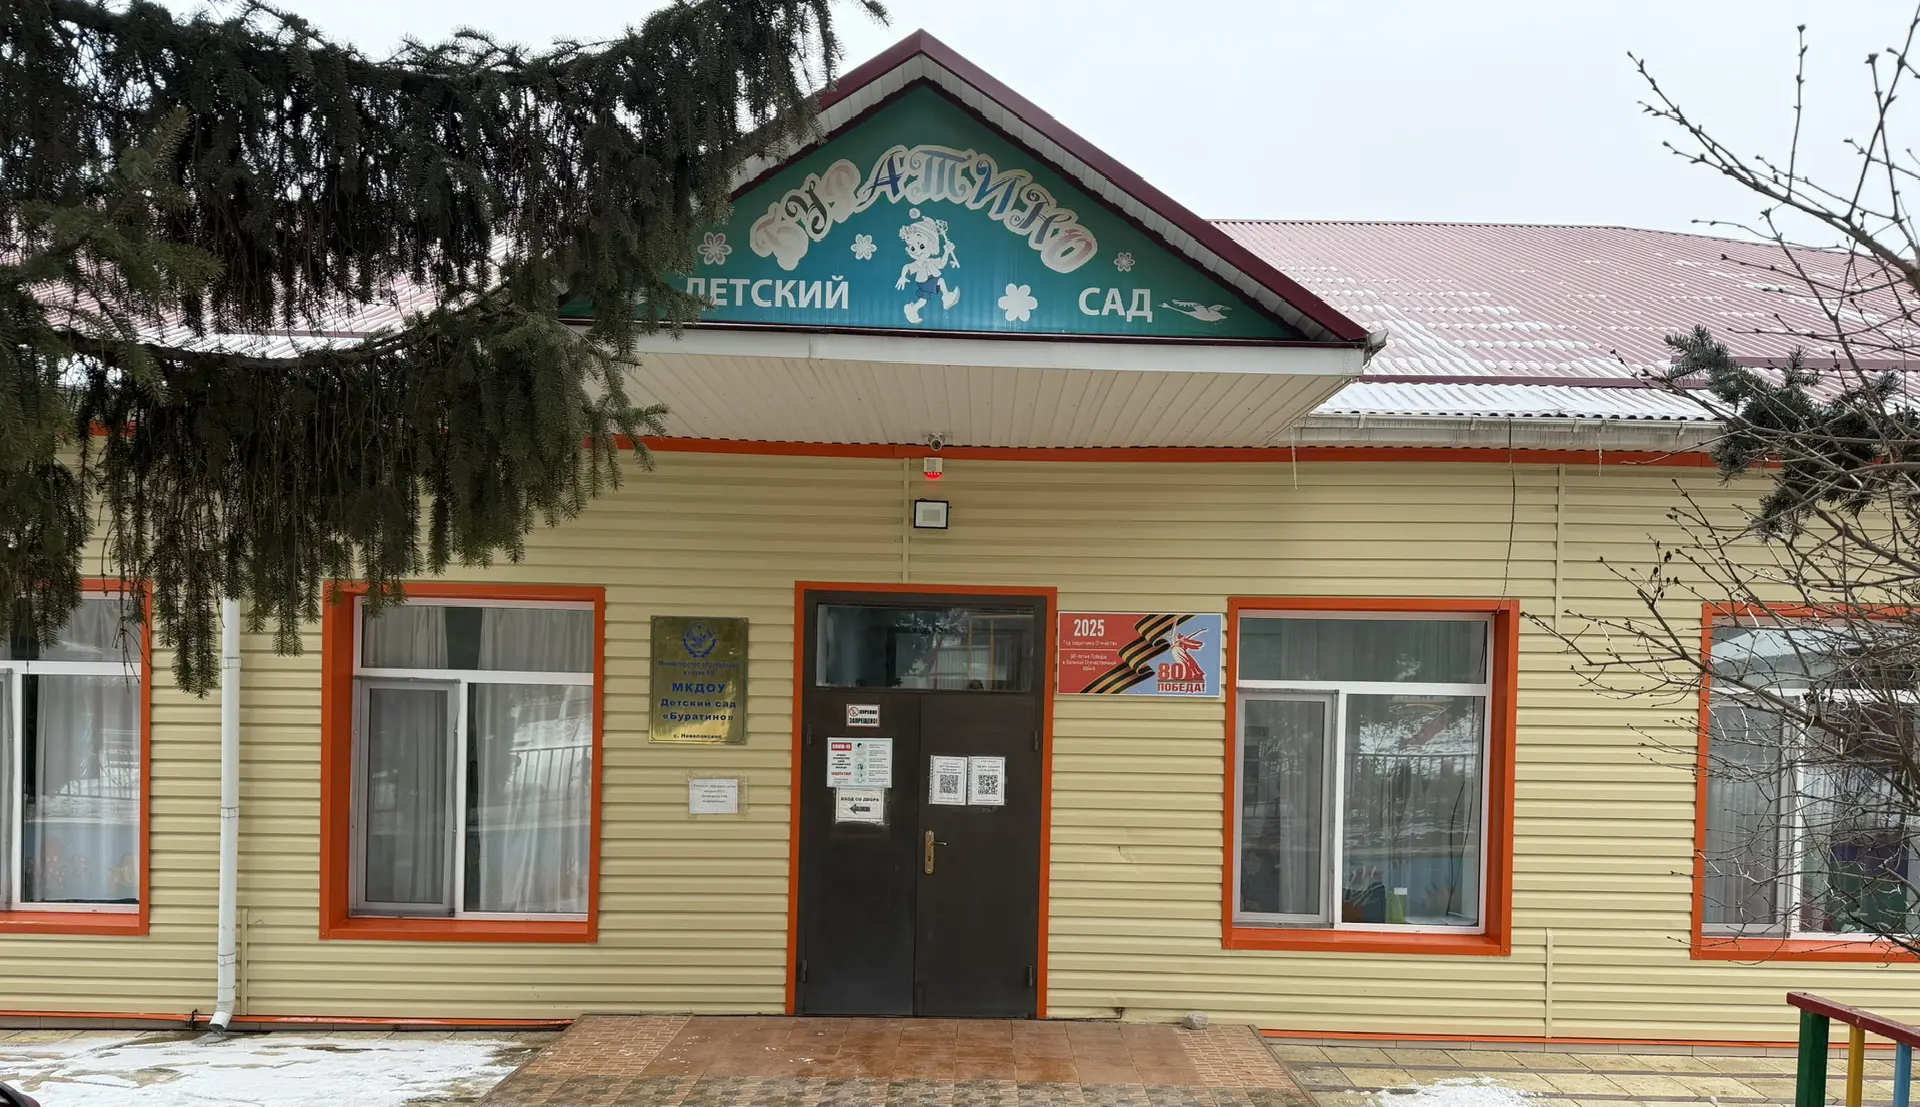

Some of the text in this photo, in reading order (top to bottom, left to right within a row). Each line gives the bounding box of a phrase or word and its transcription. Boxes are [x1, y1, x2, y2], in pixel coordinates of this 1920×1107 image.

[685, 275, 849, 310] ДЕТСКИЙ
[1078, 287, 1153, 323] САД
[1073, 619, 1105, 637] 2025
[1158, 663, 1184, 681] 80
[672, 683, 726, 695] МКДОУ
[1157, 682, 1206, 693] ПОБЕДА!
[660, 698, 737, 708] Детский сад
[663, 712, 734, 722] «Буратино»
